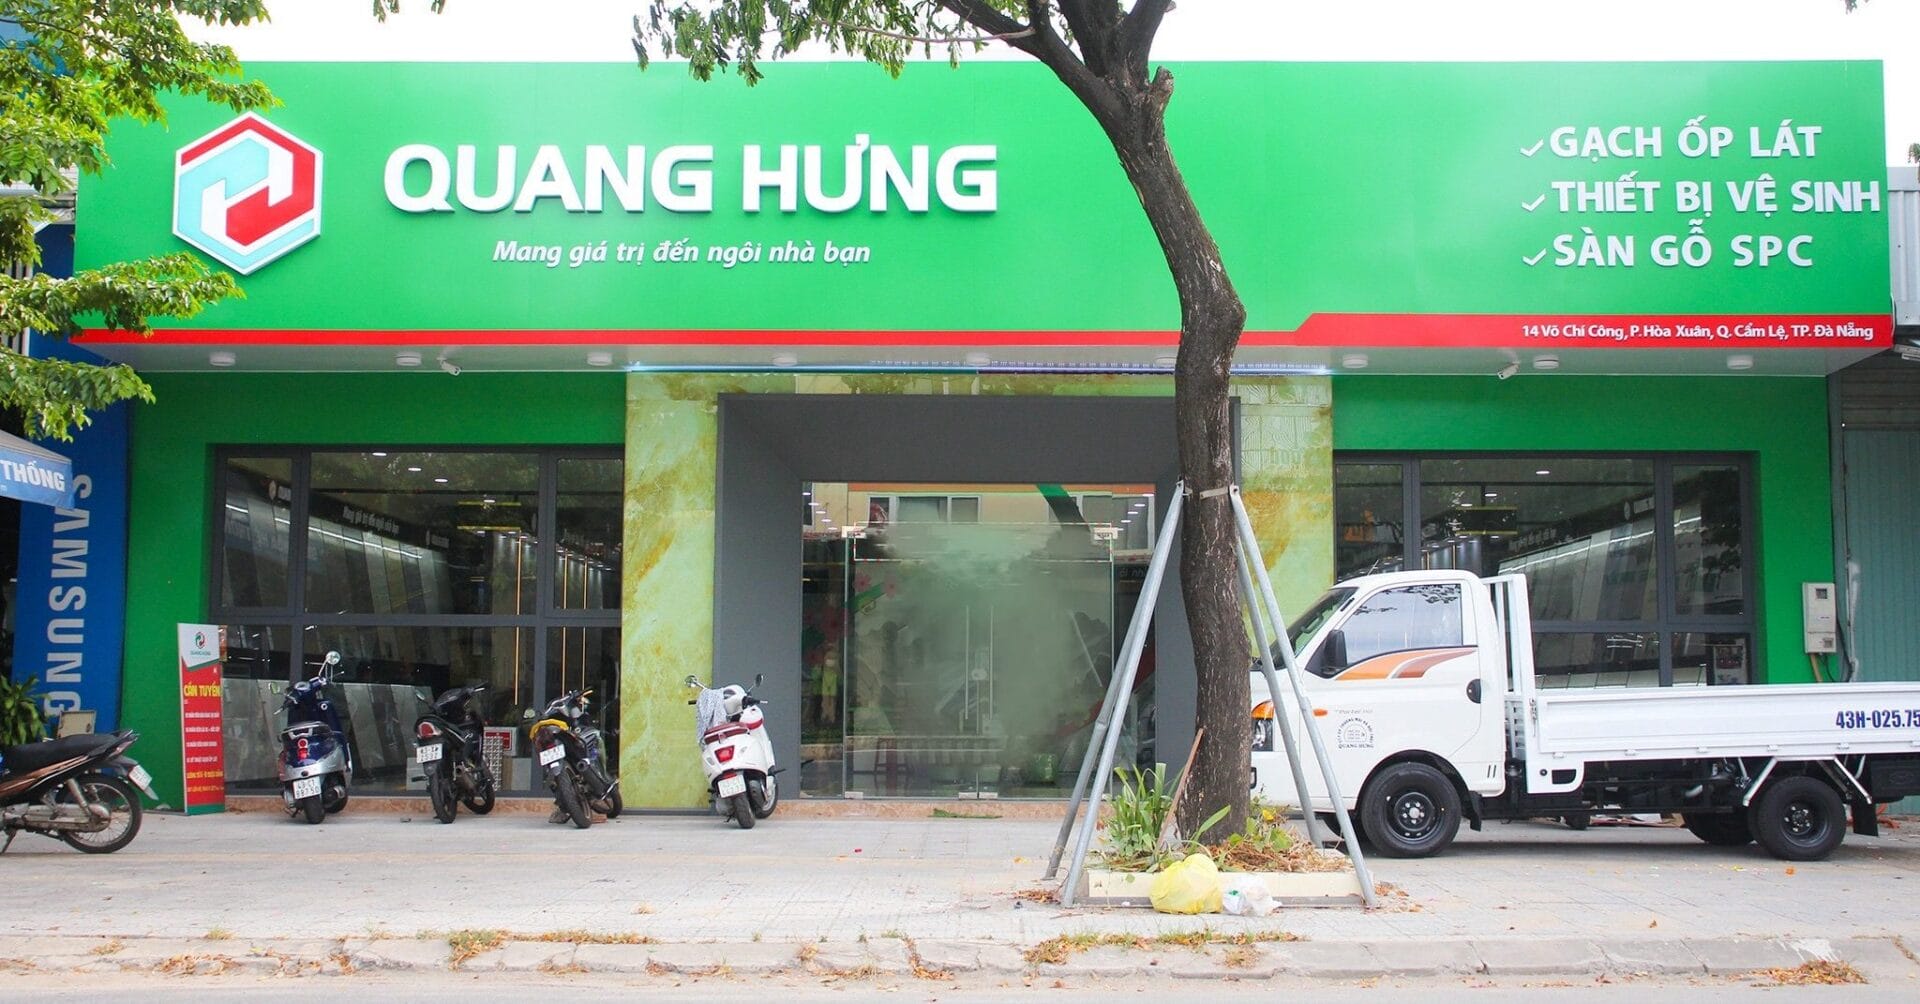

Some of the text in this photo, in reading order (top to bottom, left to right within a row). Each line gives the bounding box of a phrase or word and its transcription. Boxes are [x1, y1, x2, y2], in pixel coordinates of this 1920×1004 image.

[1549, 115, 1822, 163] GẠCH ỐP LÁT
[384, 133, 998, 213] QUANG HƯNG
[1551, 170, 1881, 218] THIẾT BỊ VỆ SINH
[492, 238, 871, 268] Mang giá trị đến ngôi nhà bạn
[1553, 219, 1813, 267] SÀN GỖ SPC
[1522, 325, 1539, 337] 14
[1541, 325, 1559, 338] Võ
[1562, 324, 1586, 338] Chí
[1588, 325, 1628, 341] Công,
[1675, 325, 1714, 340] Xuân,
[1716, 325, 1731, 338] Q.
[1768, 325, 1789, 341] Lệ,
[1791, 325, 1811, 338] TP.
[1813, 324, 1834, 338] Đà
[1836, 322, 1873, 341] Nẵng
[0, 460, 65, 492] THỐNG
[43, 474, 93, 717] SAMSUNG
[1836, 709, 1920, 729] 43H-025.75
